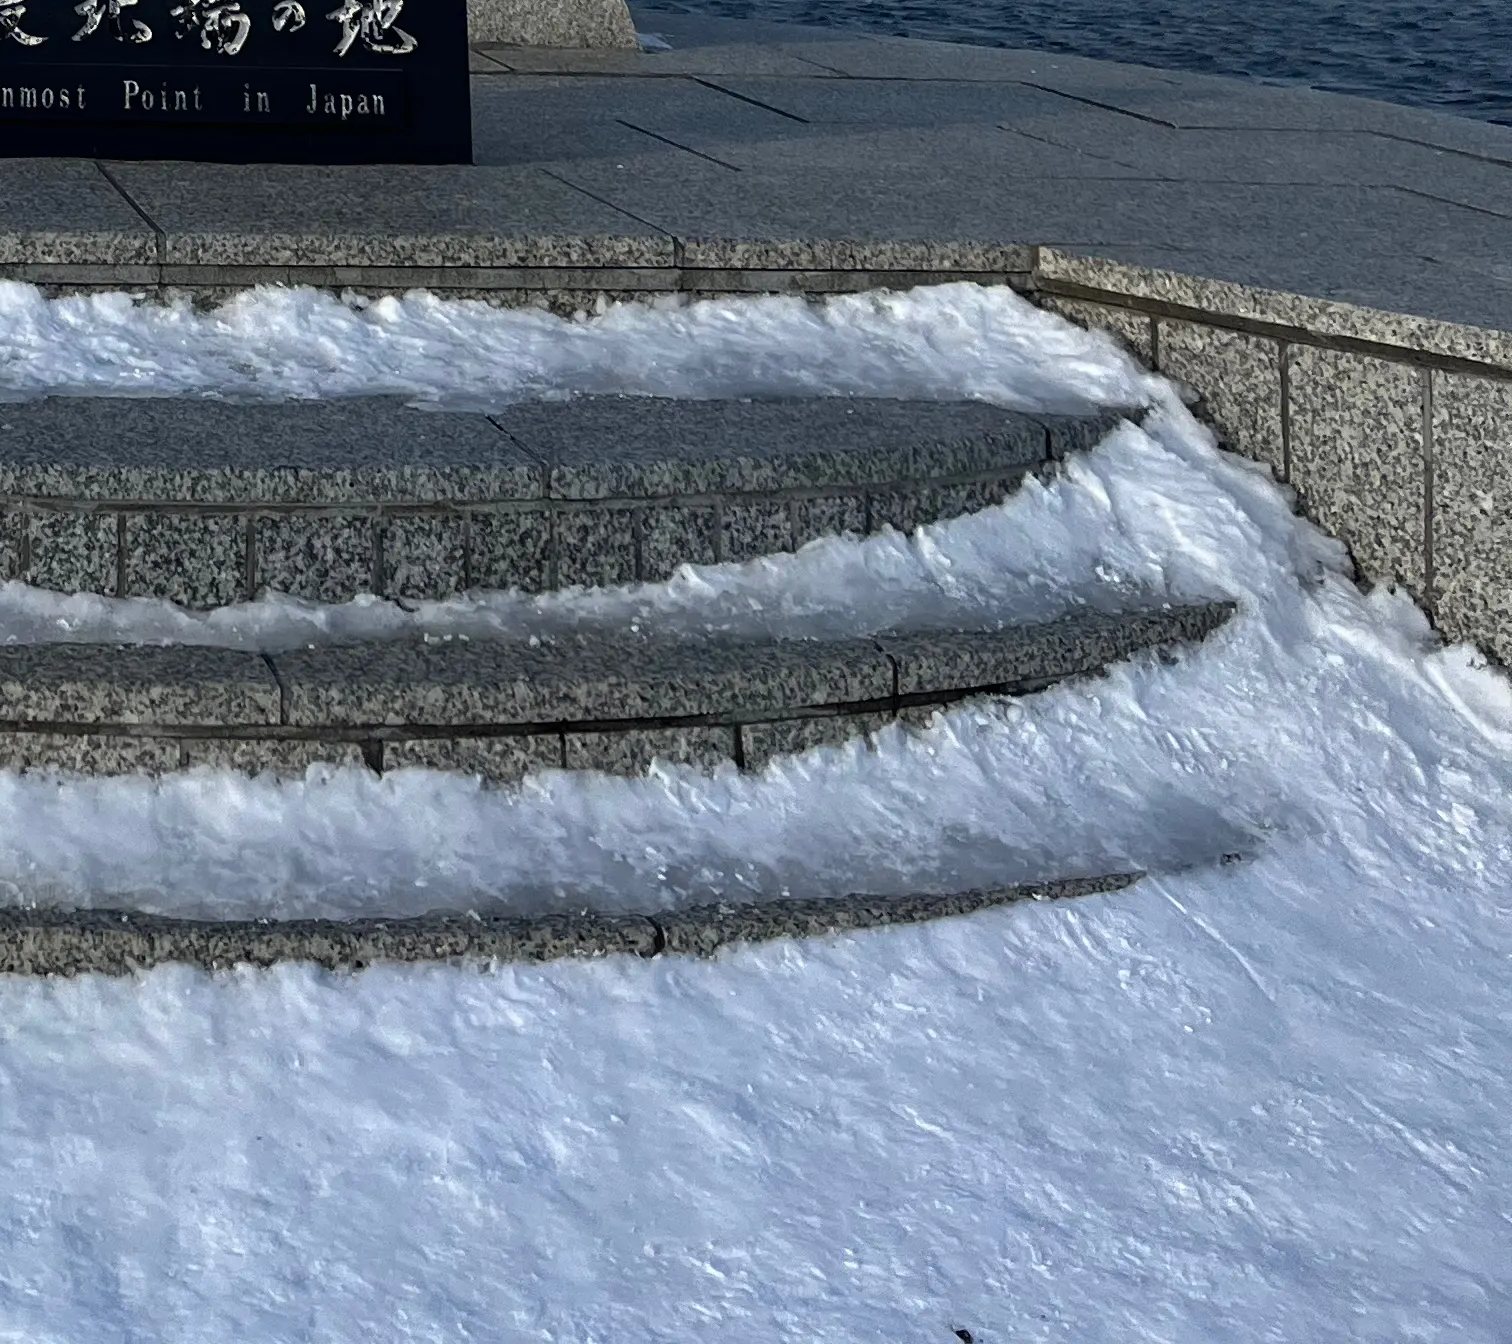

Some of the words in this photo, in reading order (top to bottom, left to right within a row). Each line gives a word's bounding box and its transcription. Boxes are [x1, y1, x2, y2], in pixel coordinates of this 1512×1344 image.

[123, 80, 204, 112] Point
[243, 83, 271, 114] in
[306, 83, 386, 120] Japan
